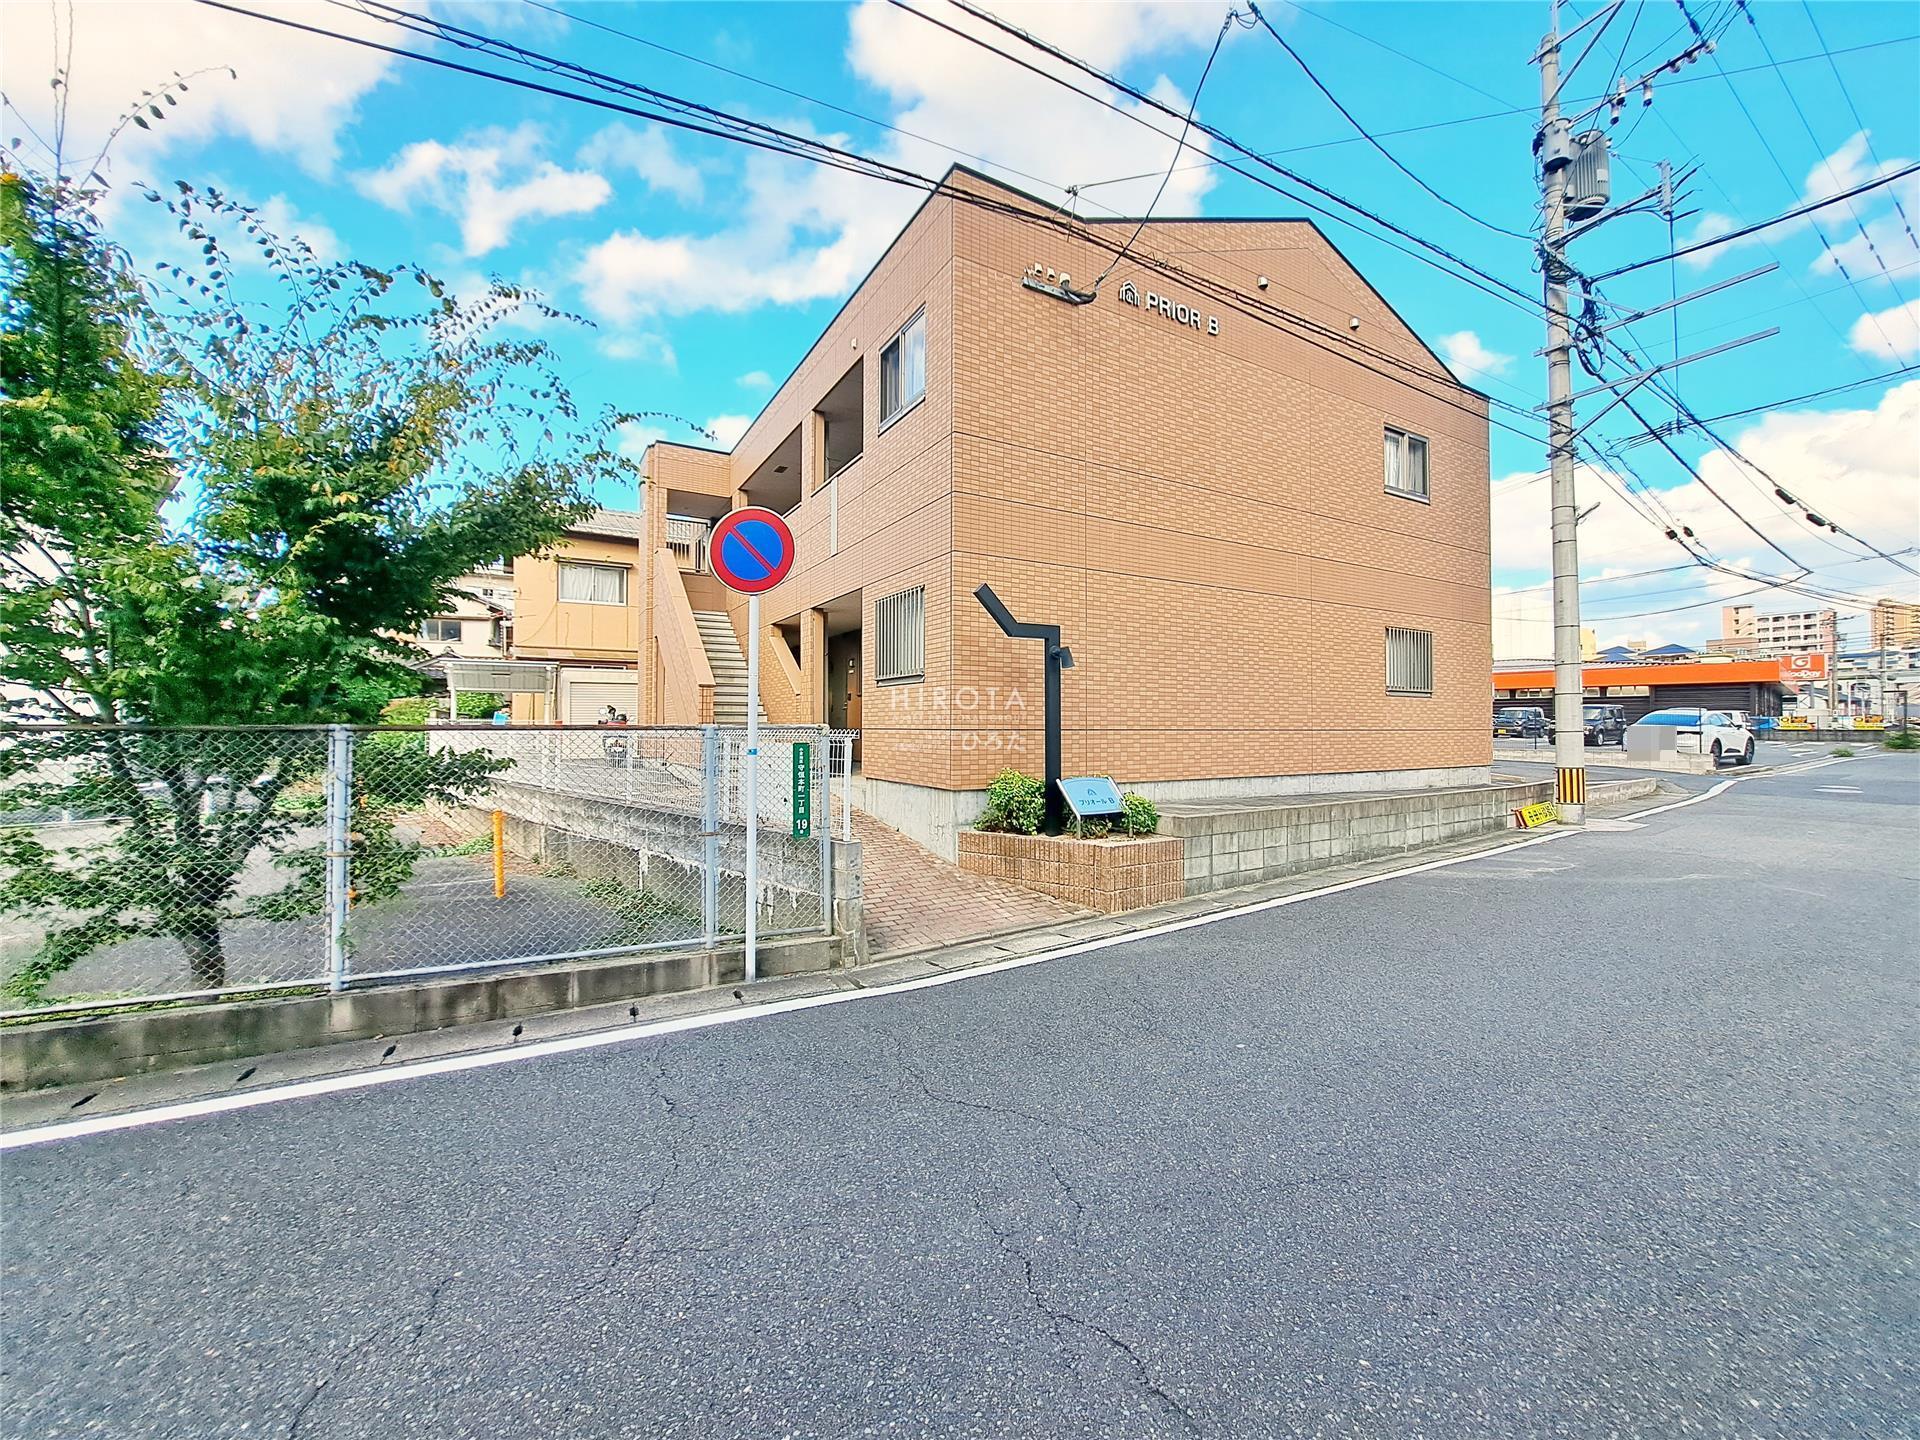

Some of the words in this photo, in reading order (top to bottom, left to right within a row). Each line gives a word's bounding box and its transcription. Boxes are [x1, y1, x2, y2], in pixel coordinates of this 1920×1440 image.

[1145, 291, 1200, 330] PRIOR
[1207, 315, 1219, 336] B
[796, 819, 808, 830] 19
